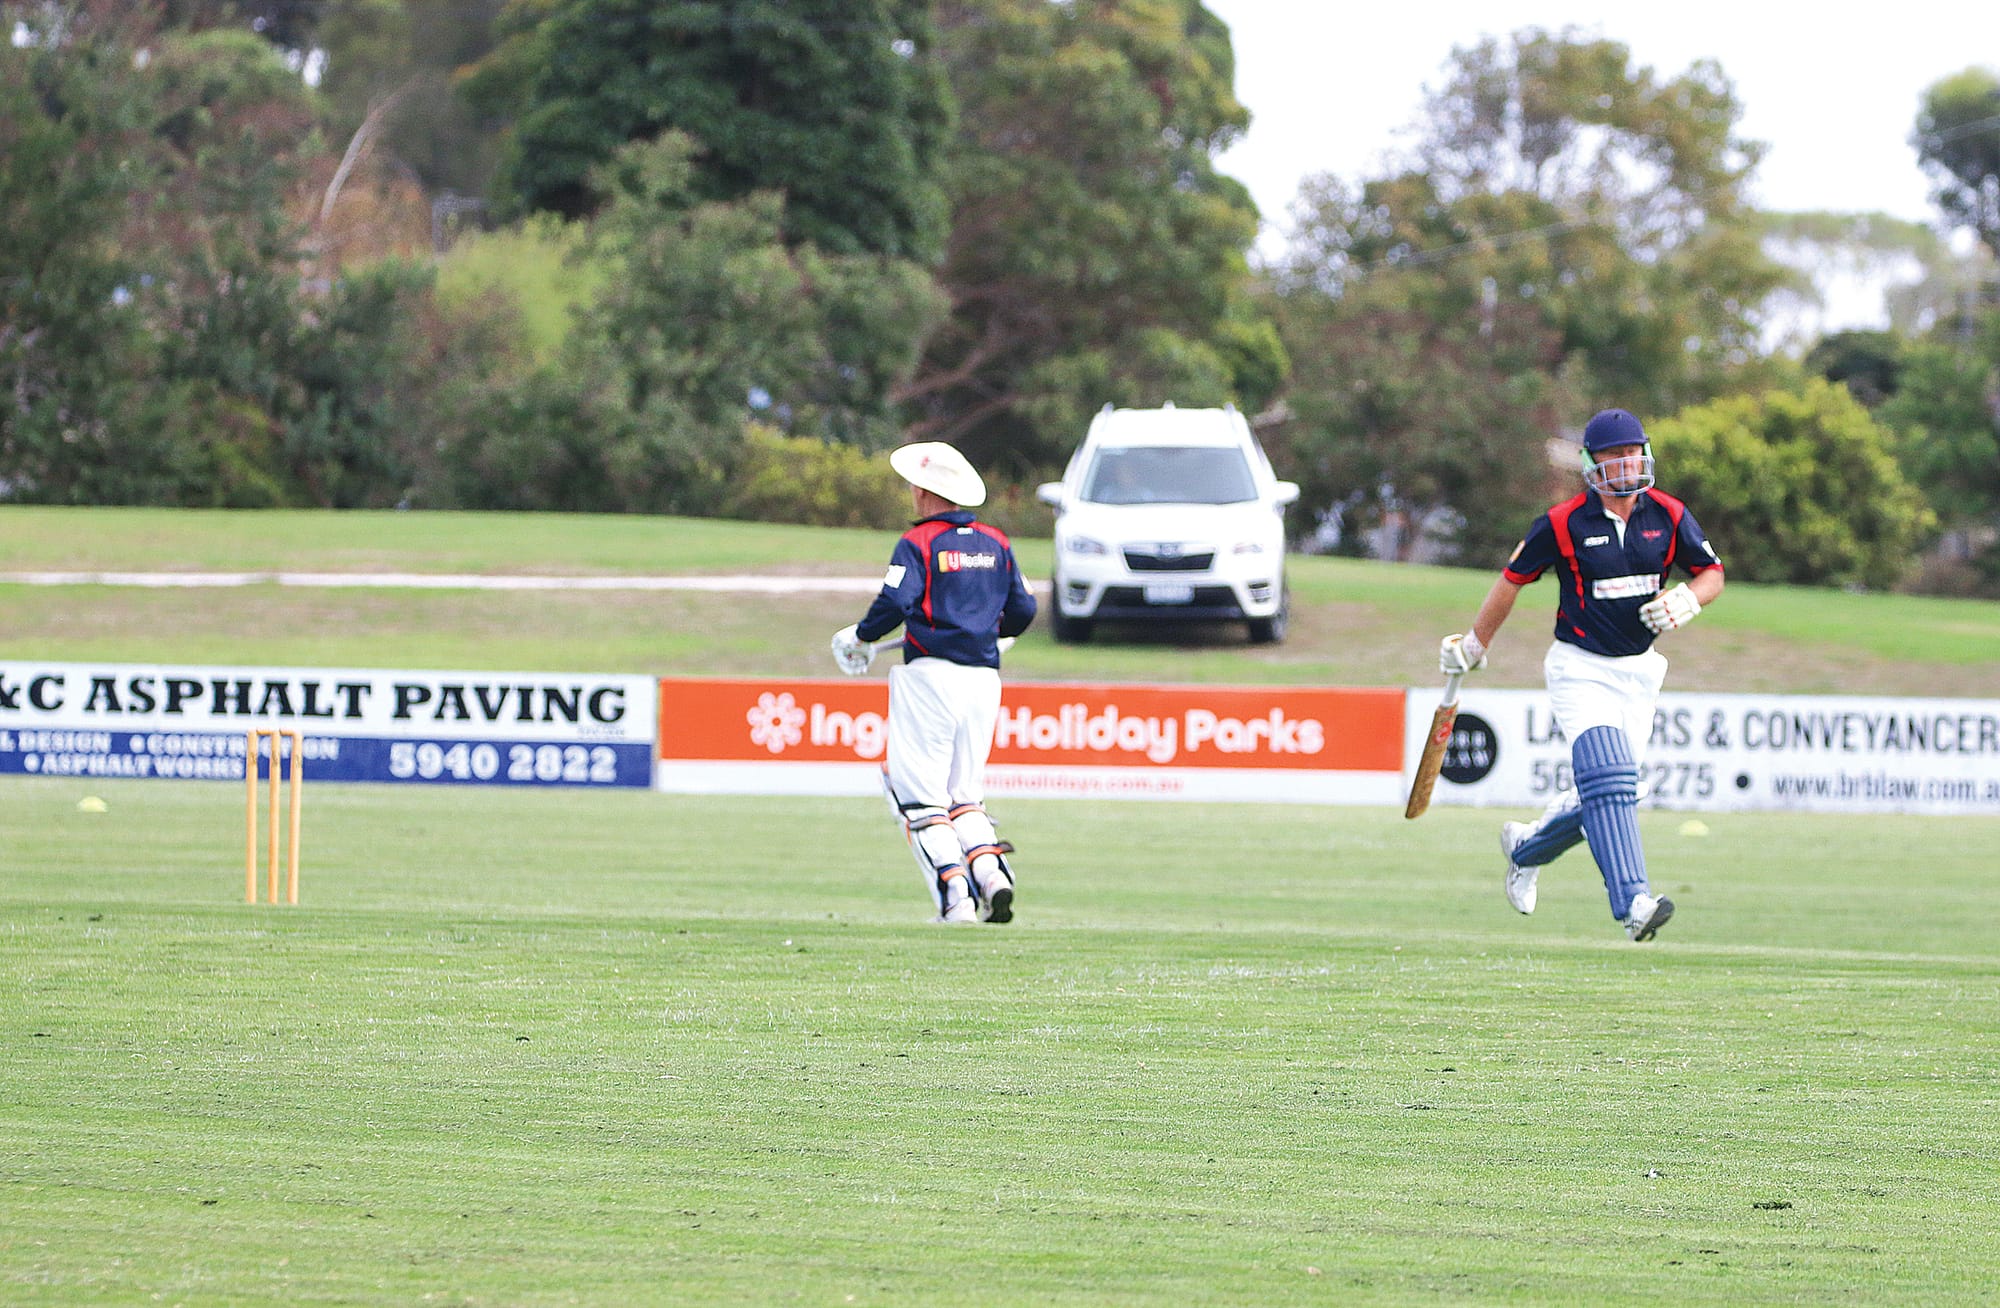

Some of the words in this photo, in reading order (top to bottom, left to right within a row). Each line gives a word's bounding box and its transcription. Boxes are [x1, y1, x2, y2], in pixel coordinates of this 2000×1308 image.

[84, 677, 371, 717] ASPHALT
[392, 683, 625, 722] PAVING
[18, 731, 111, 754] DESIGN
[994, 703, 1178, 764] Holiday
[1185, 708, 1325, 754] Parks
[1527, 705, 1691, 747] LARS
[1705, 711, 1729, 748] &
[1743, 711, 1999, 752] CONVEYANCER
[42, 753, 150, 776] ASPHALT
[153, 755, 244, 778] WORKS
[390, 742, 499, 779] 5940
[507, 744, 617, 782] 2822
